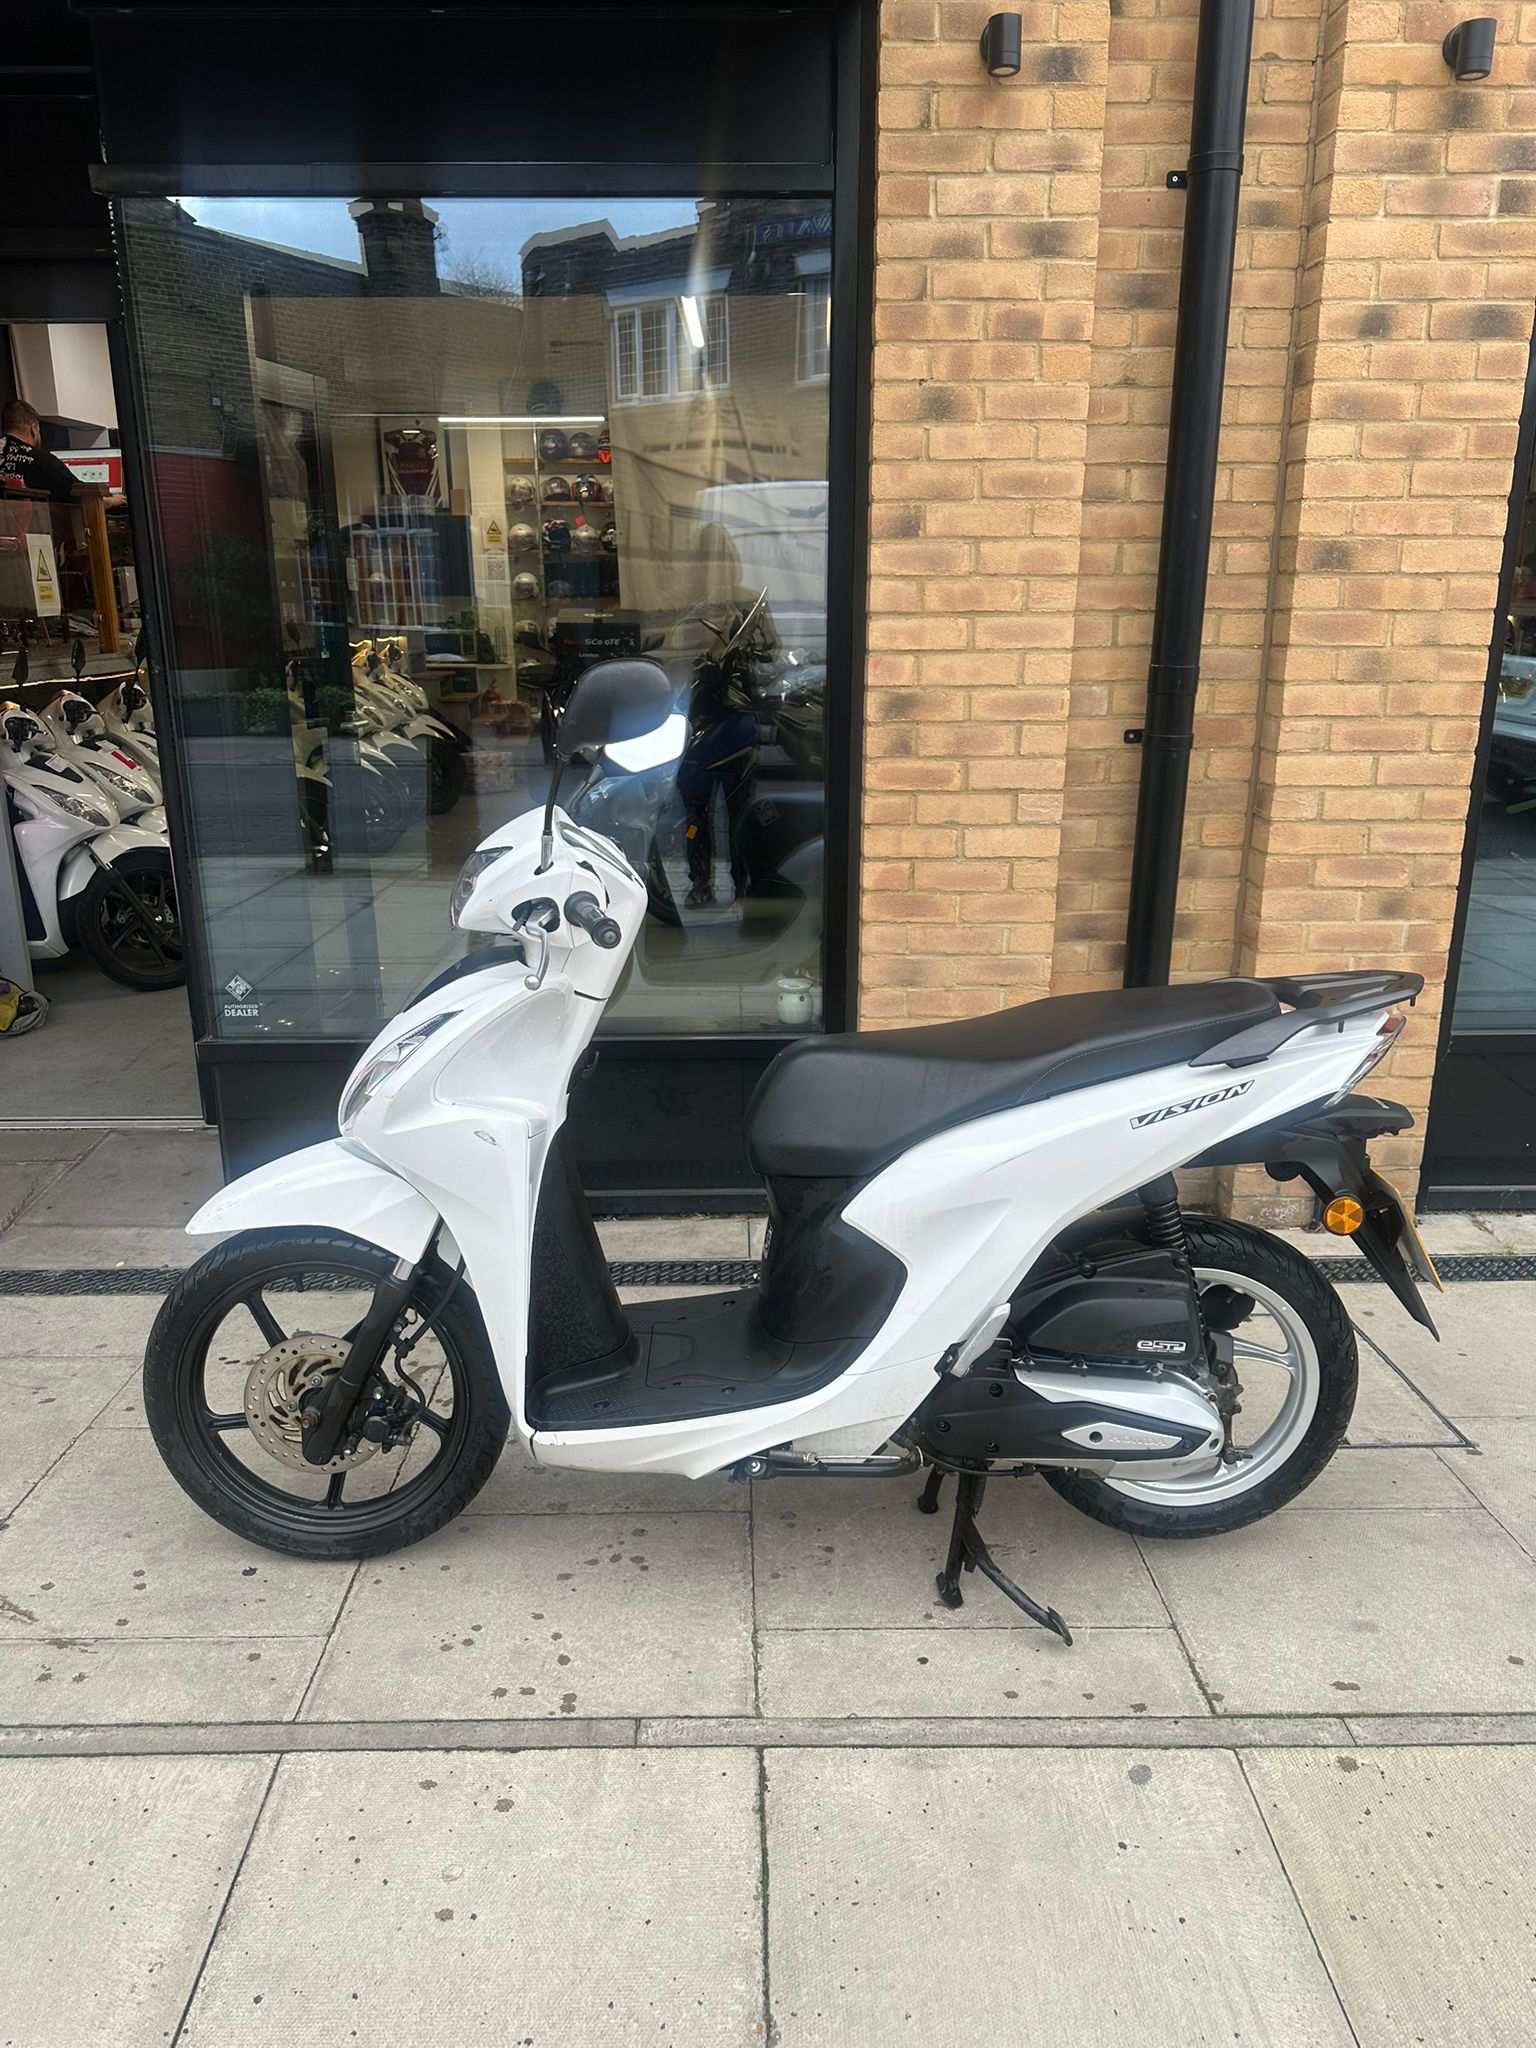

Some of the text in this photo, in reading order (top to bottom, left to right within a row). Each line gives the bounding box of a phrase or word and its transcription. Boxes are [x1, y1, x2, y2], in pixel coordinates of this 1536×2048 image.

[224, 1009, 259, 1017] DEALER
[1130, 1080, 1255, 1129] VISION
[1108, 1434, 1168, 1447] HONDA
